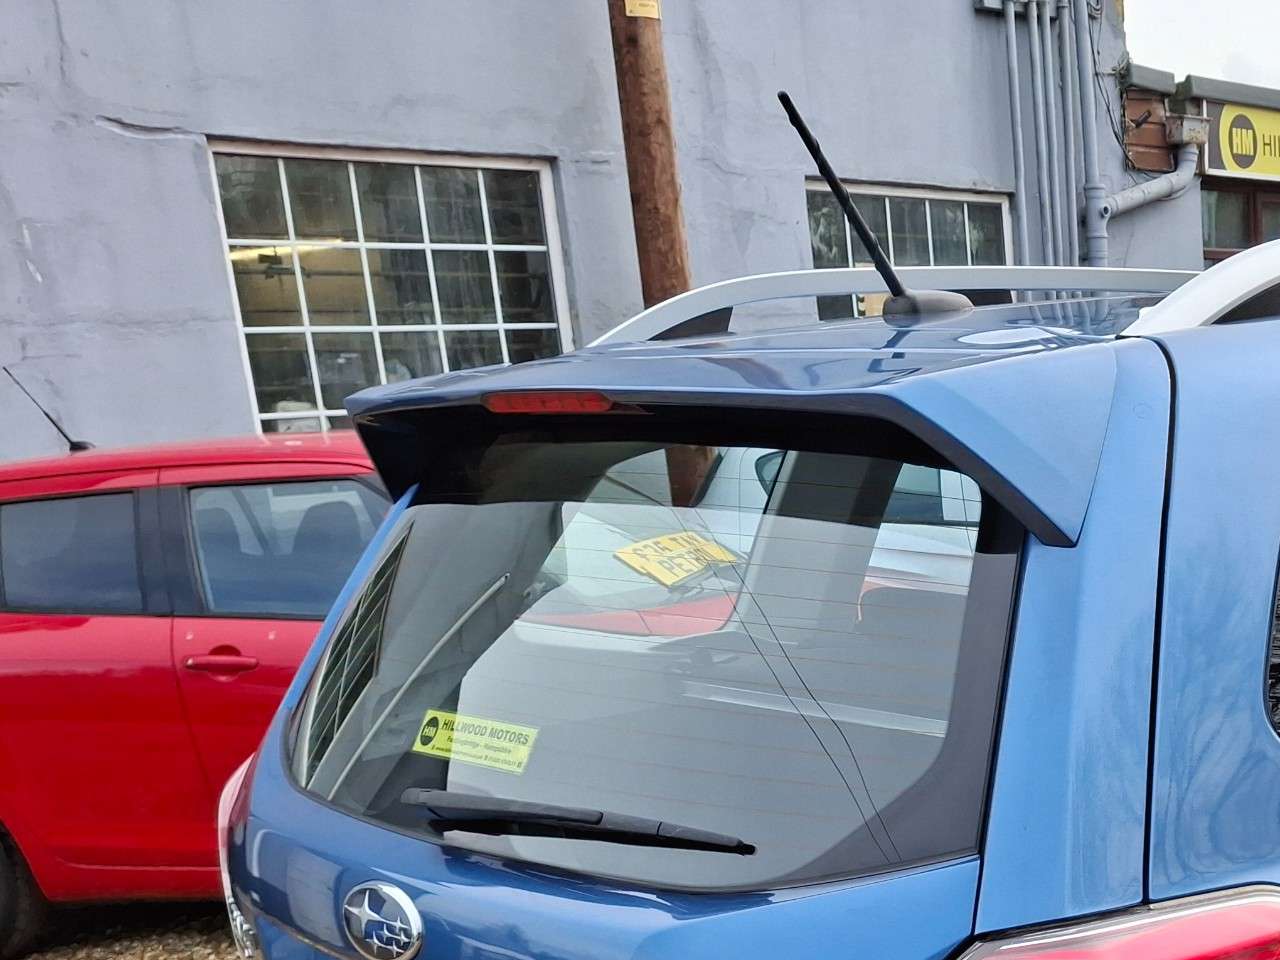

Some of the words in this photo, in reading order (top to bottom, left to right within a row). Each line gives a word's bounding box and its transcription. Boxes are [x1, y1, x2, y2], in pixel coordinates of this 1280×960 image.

[1232, 127, 1254, 156] HM
[441, 719, 487, 737] HILLWOOD
[488, 726, 530, 745] MOTORS
